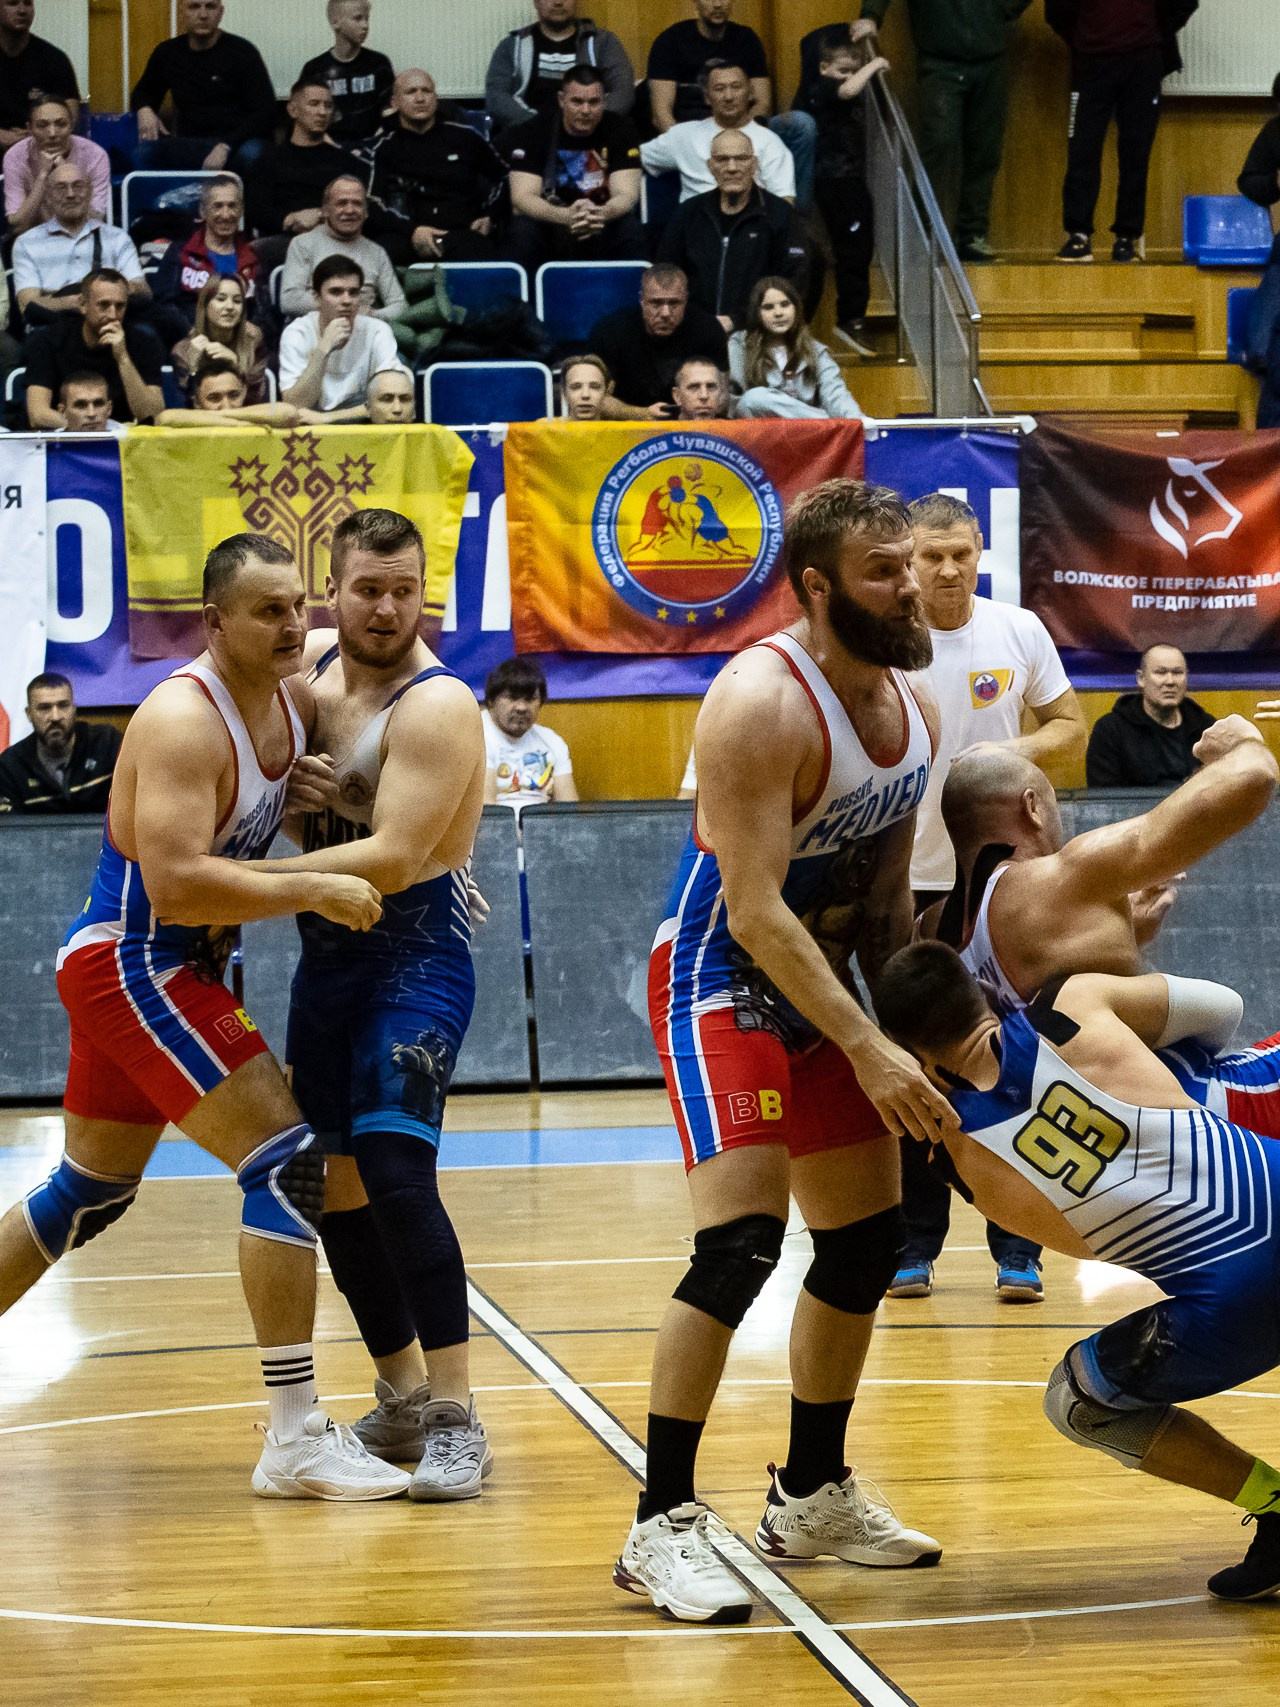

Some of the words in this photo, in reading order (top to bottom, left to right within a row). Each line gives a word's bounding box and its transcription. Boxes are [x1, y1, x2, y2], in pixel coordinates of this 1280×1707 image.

[607, 440, 669, 489] Регбола
[672, 434, 765, 482] Чувашской
[597, 492, 626, 588] Федерация
[755, 481, 785, 585] Республики
[1053, 569, 1148, 589] ВОЛЖСКОЕ
[1131, 593, 1257, 611] ПРЕДПРИЯТИЕ
[825, 775, 874, 816] RUSSKIE
[728, 1089, 783, 1125] BB
[1012, 1080, 1131, 1198] 93
